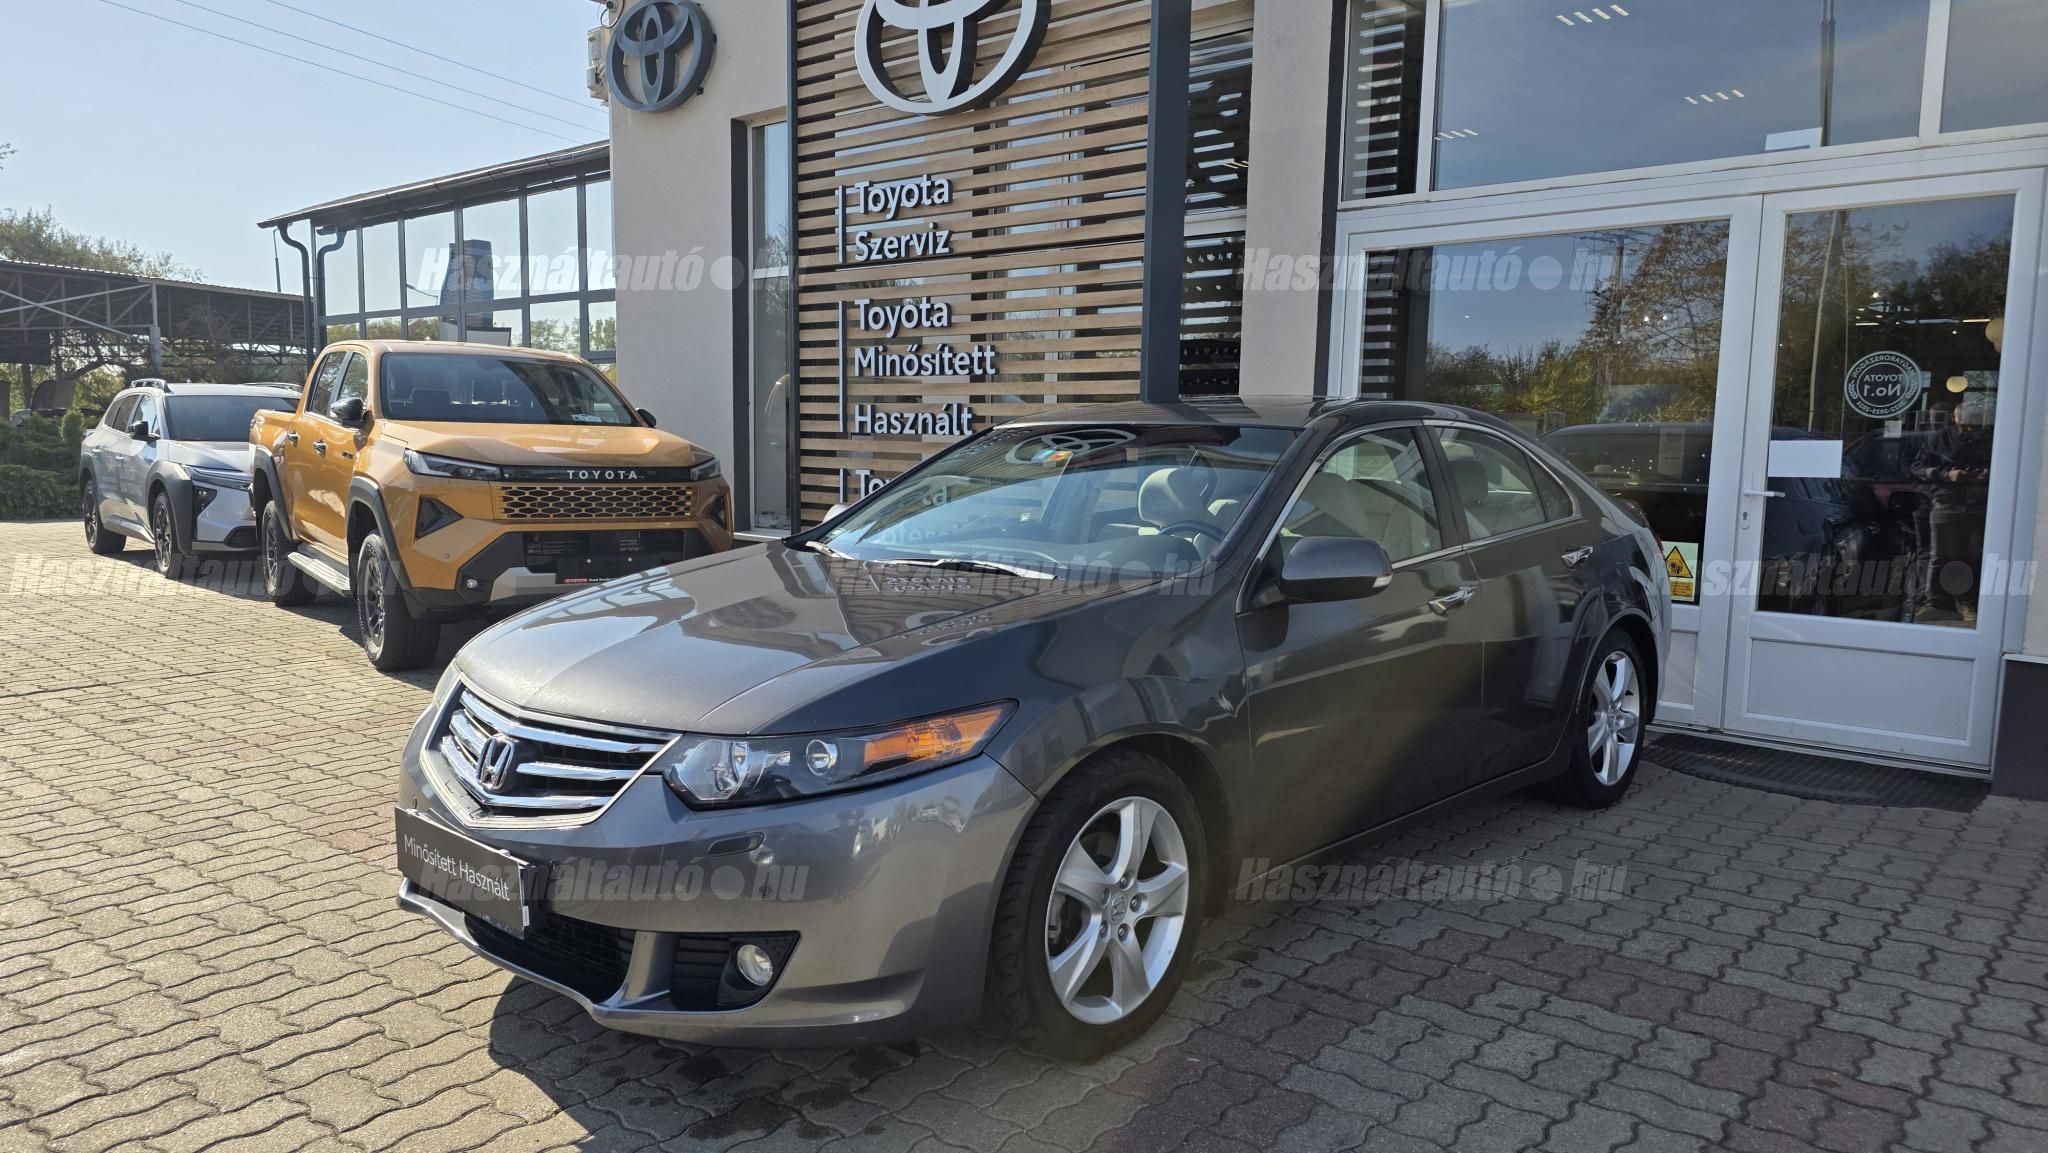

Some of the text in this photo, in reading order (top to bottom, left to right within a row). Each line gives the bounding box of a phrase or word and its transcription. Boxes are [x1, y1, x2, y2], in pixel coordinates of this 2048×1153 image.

[854, 173, 950, 220] Toyota
[854, 222, 950, 262] Szerviz
[854, 296, 949, 339] Toyota
[854, 344, 997, 377] Minősített
[854, 403, 974, 436] Használt
[567, 470, 638, 480] TOYOTA
[404, 833, 511, 902] Minősített Használt
